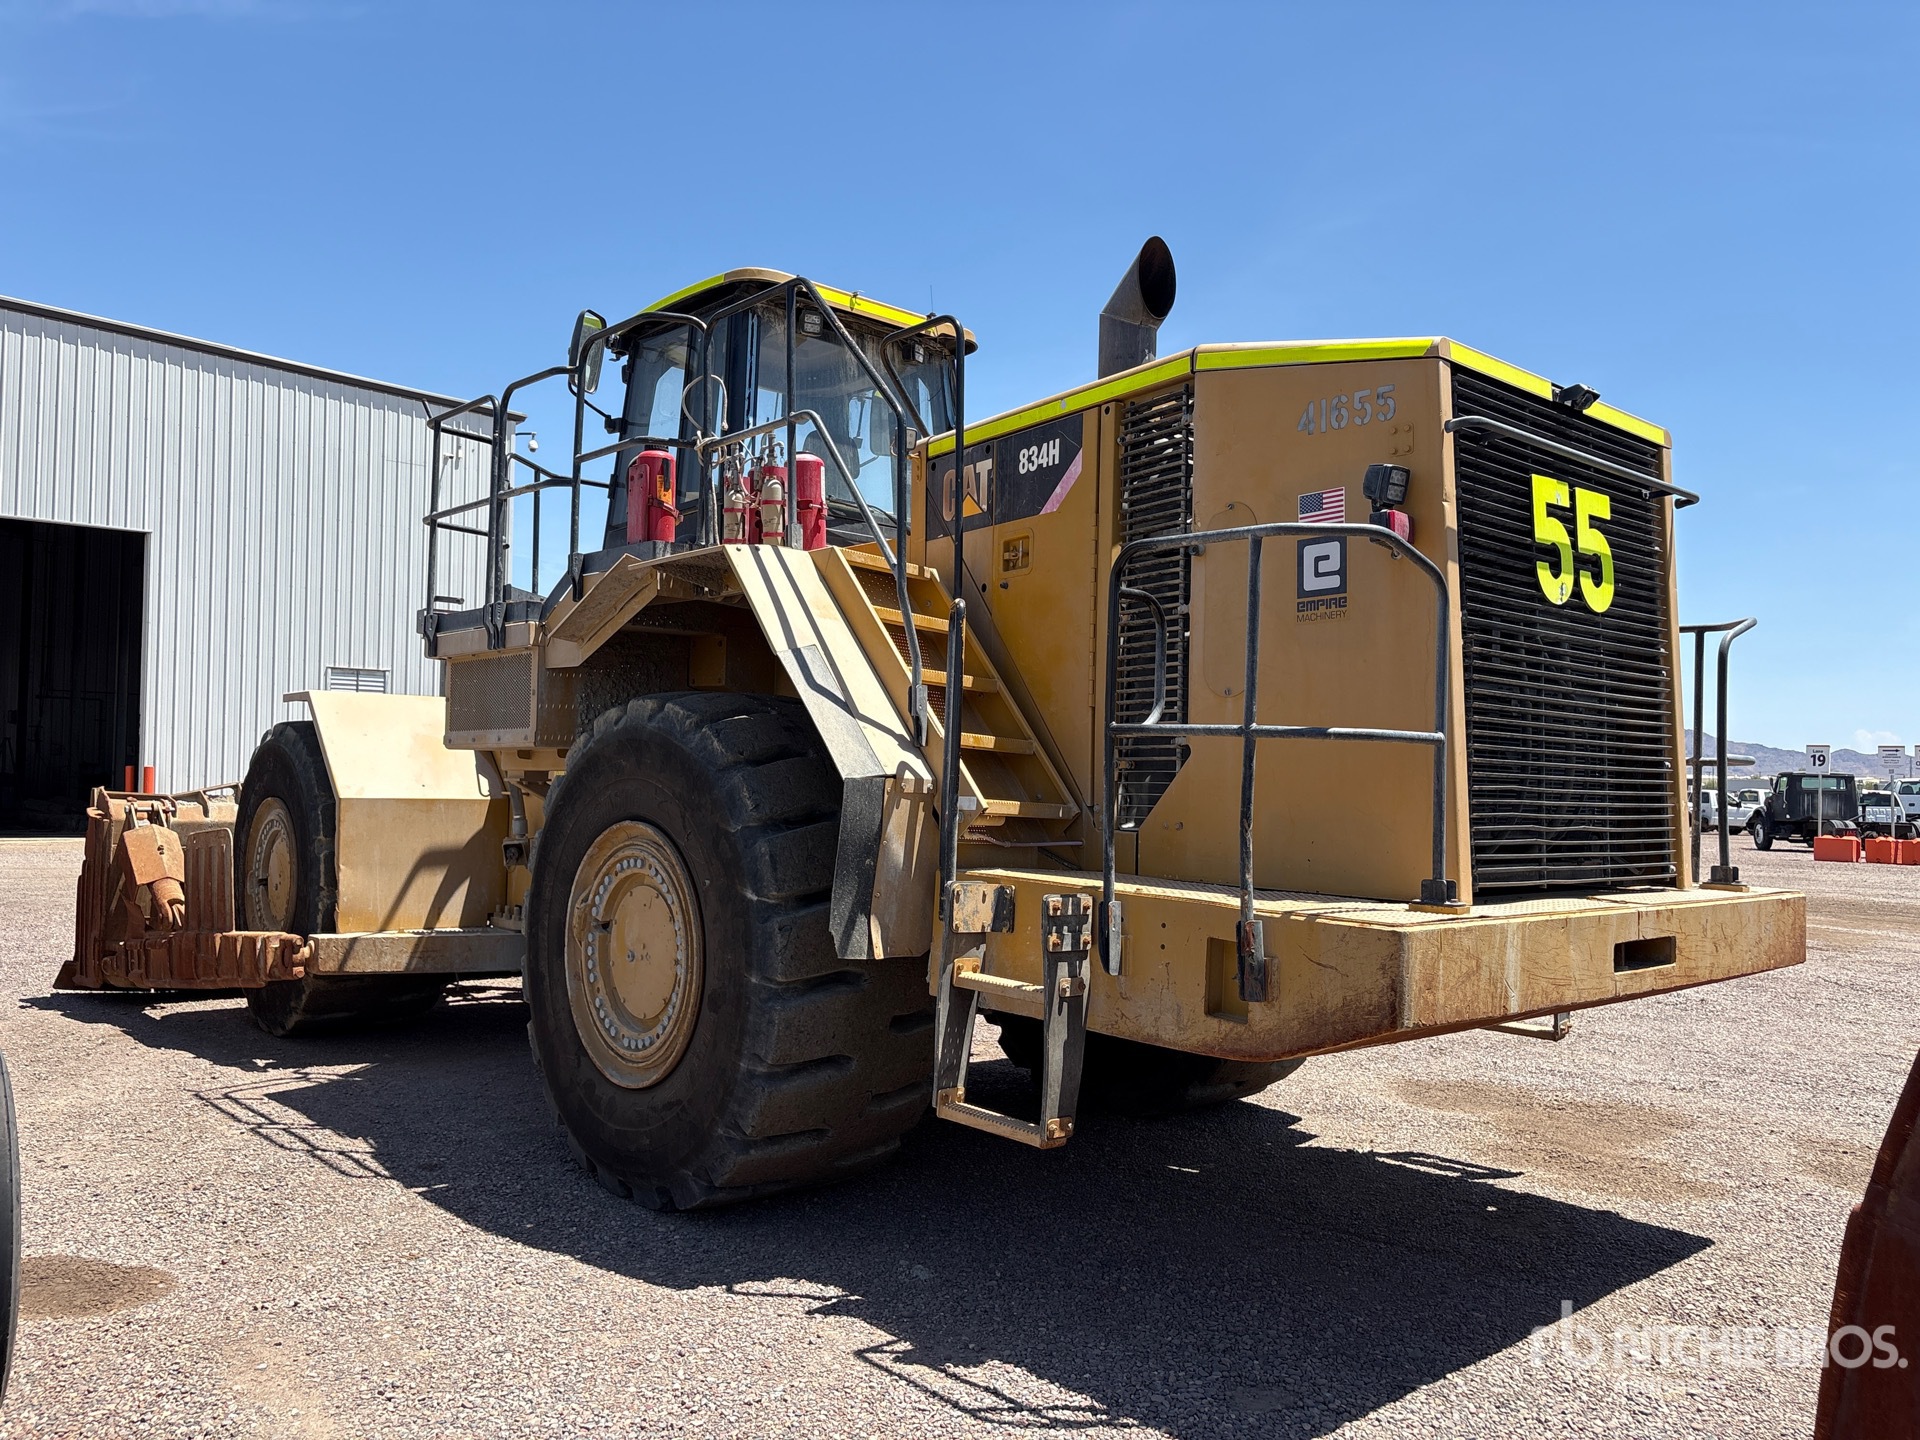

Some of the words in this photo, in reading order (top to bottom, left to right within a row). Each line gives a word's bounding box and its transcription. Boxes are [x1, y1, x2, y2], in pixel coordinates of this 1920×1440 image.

[1297, 384, 1396, 435] 41655
[1018, 438, 1060, 475] 834H
[942, 458, 993, 522] CAT
[1530, 473, 1614, 613] 55
[1296, 610, 1348, 623] MACHINERY
[1810, 754, 1826, 767] 19
